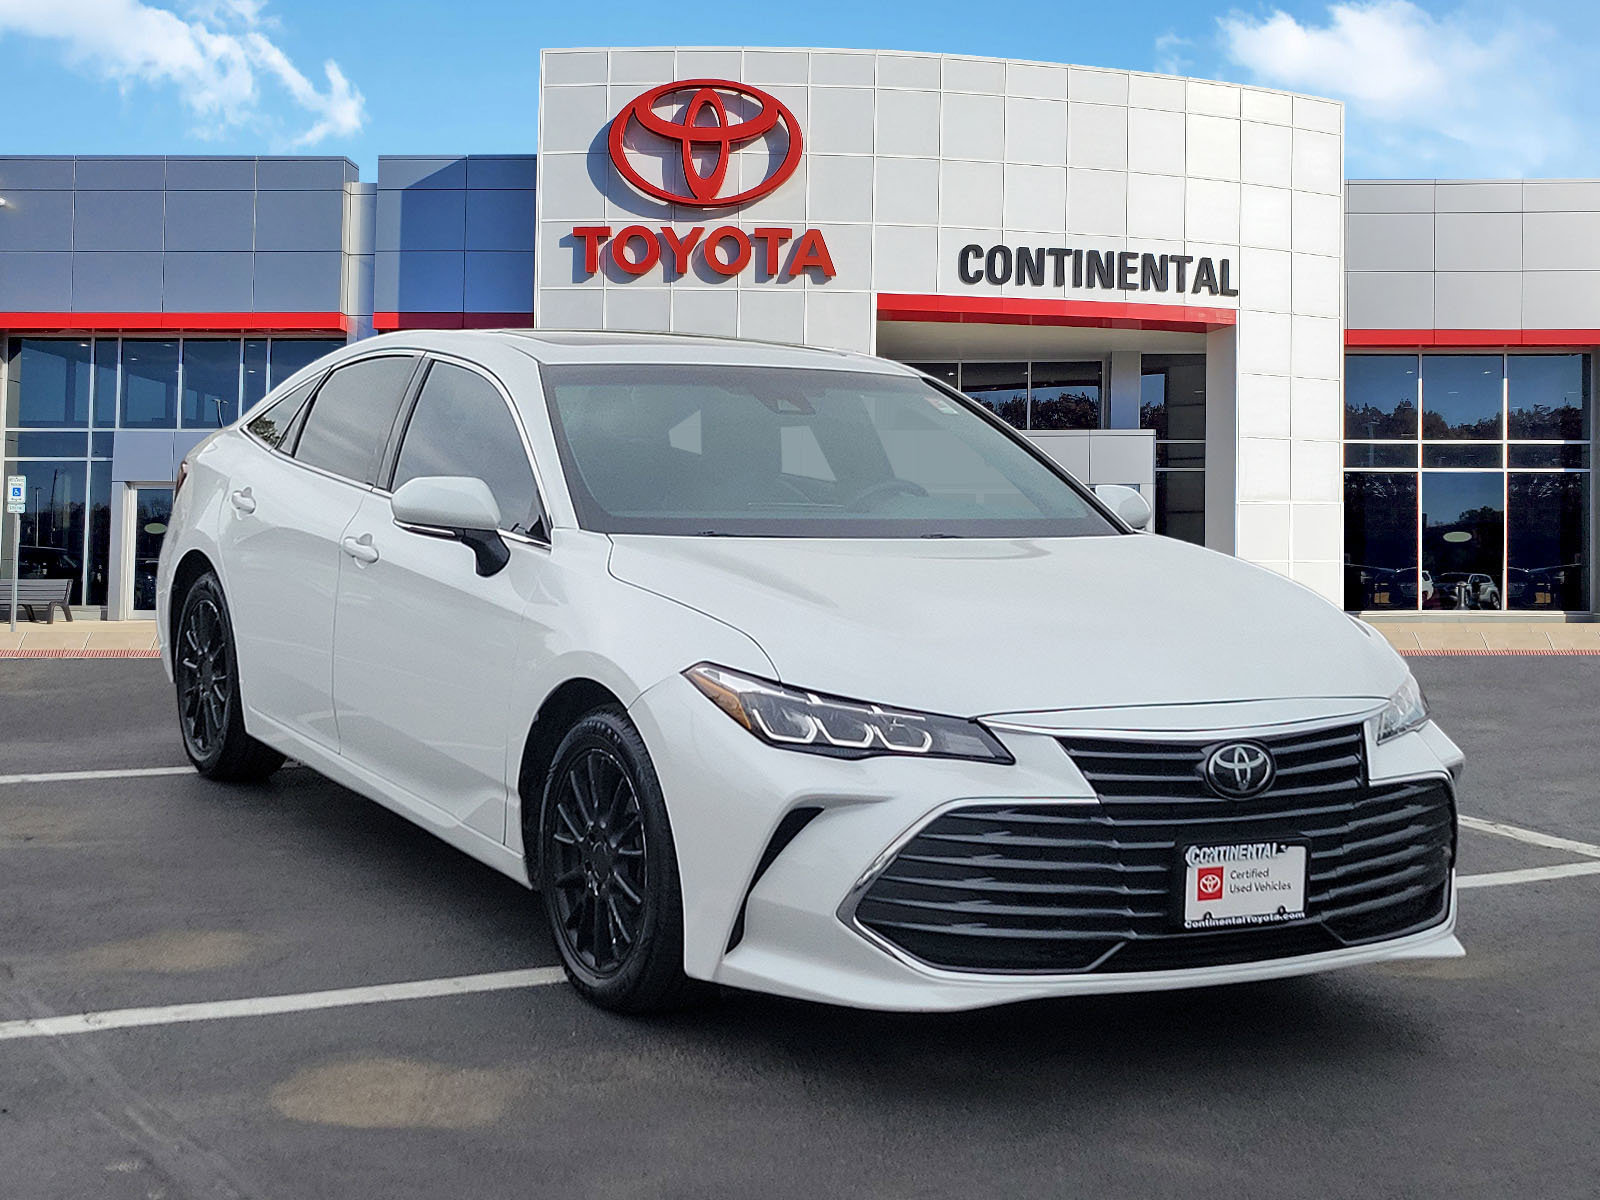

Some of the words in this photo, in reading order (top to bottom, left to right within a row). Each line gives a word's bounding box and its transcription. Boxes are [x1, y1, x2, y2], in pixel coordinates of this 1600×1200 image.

[572, 225, 837, 278] TOYOTA
[958, 244, 1239, 297] CONTINENTAL
[1186, 842, 1279, 866] CONTINENTAL
[1230, 867, 1270, 880] Certified
[1229, 883, 1252, 894] Used
[1254, 881, 1292, 892] Vehicles
